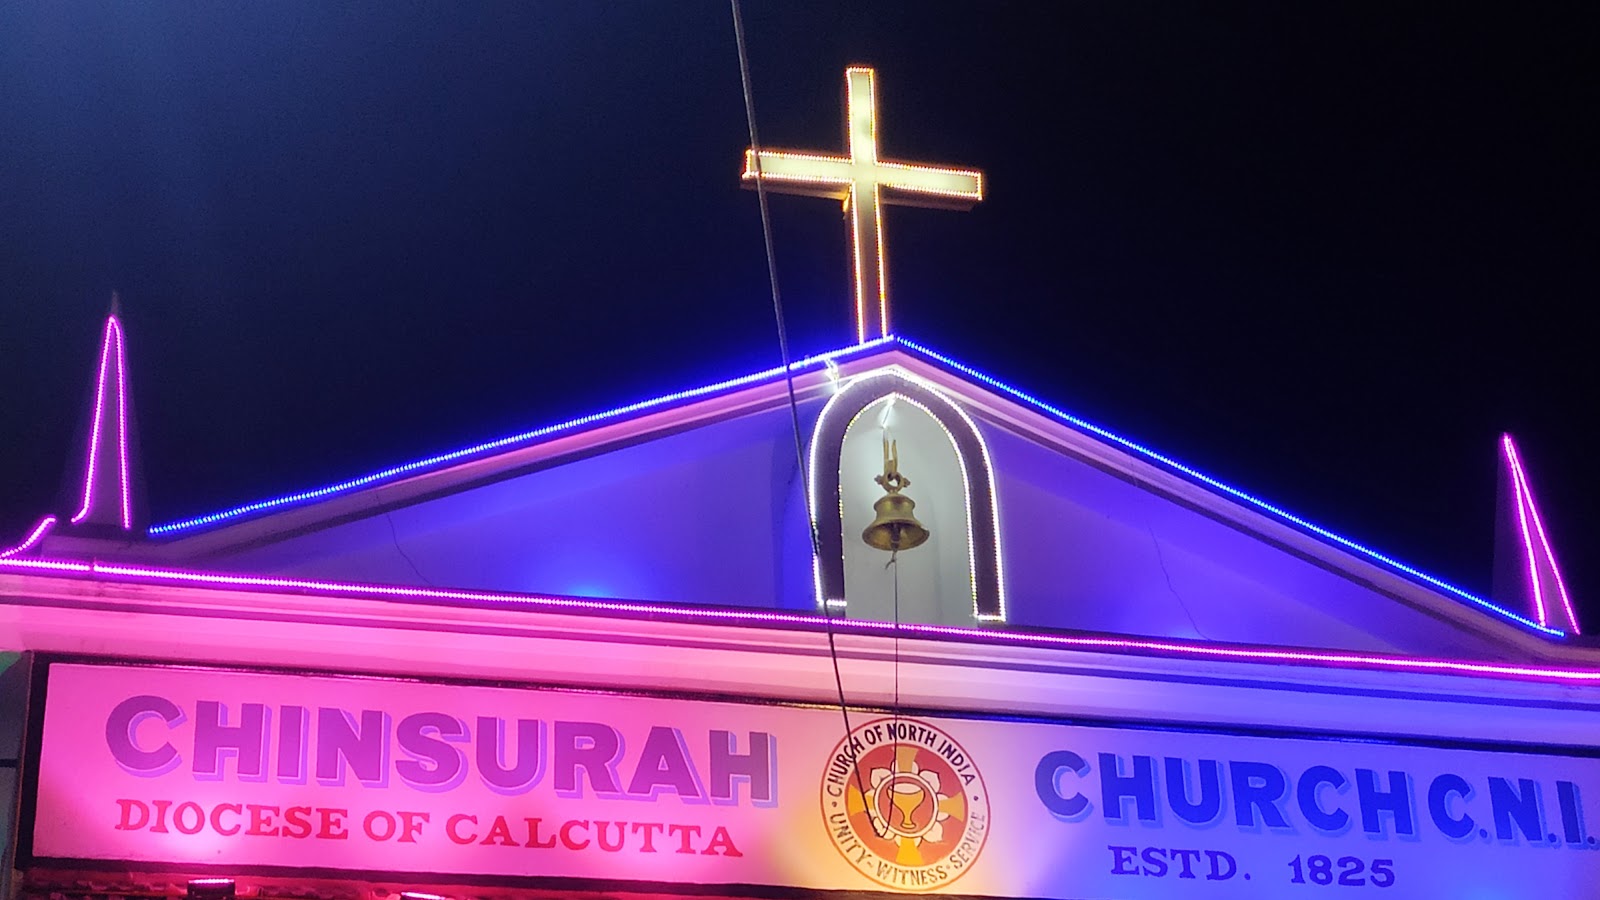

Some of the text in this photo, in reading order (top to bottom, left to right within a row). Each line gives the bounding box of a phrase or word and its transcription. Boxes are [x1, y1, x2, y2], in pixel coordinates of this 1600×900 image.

[105, 695, 774, 804] CHINSURAH
[1035, 750, 1416, 838] CHURCH
[827, 723, 976, 797] CHURCH OF NORTH INDIA
[115, 798, 743, 858] DIOCESE OF CALCUTTA
[876, 860, 948, 887] WITNESS
[949, 811, 985, 870] SERVICE
[1108, 845, 1395, 888] ESTD. 1825
